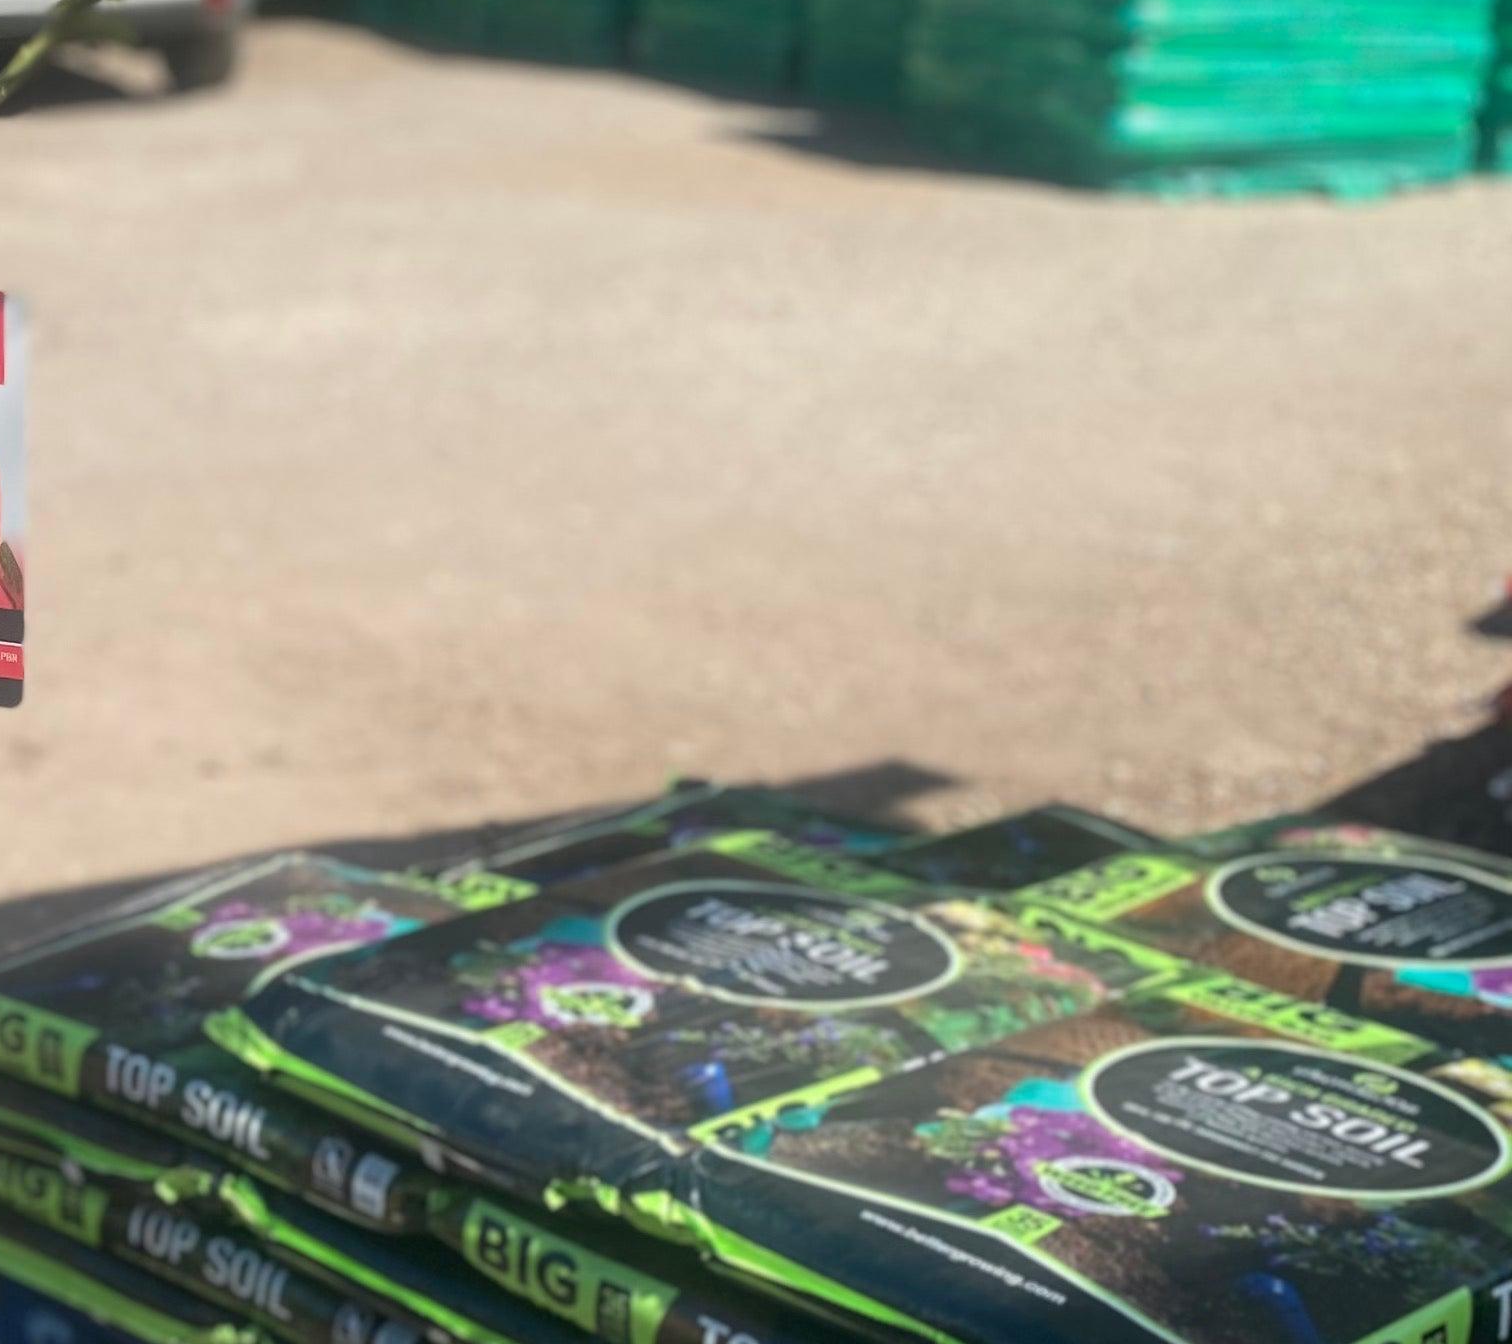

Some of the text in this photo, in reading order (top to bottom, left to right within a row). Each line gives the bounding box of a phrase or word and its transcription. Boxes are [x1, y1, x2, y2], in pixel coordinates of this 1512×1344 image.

[106, 1044, 176, 1107] TOP
[181, 1079, 270, 1160] SOIL
[1168, 1055, 1290, 1105] TOP
[1290, 1102, 1431, 1169] SOIL
[128, 1206, 293, 1322] TOP SOIL
[479, 1218, 577, 1305] BIG
